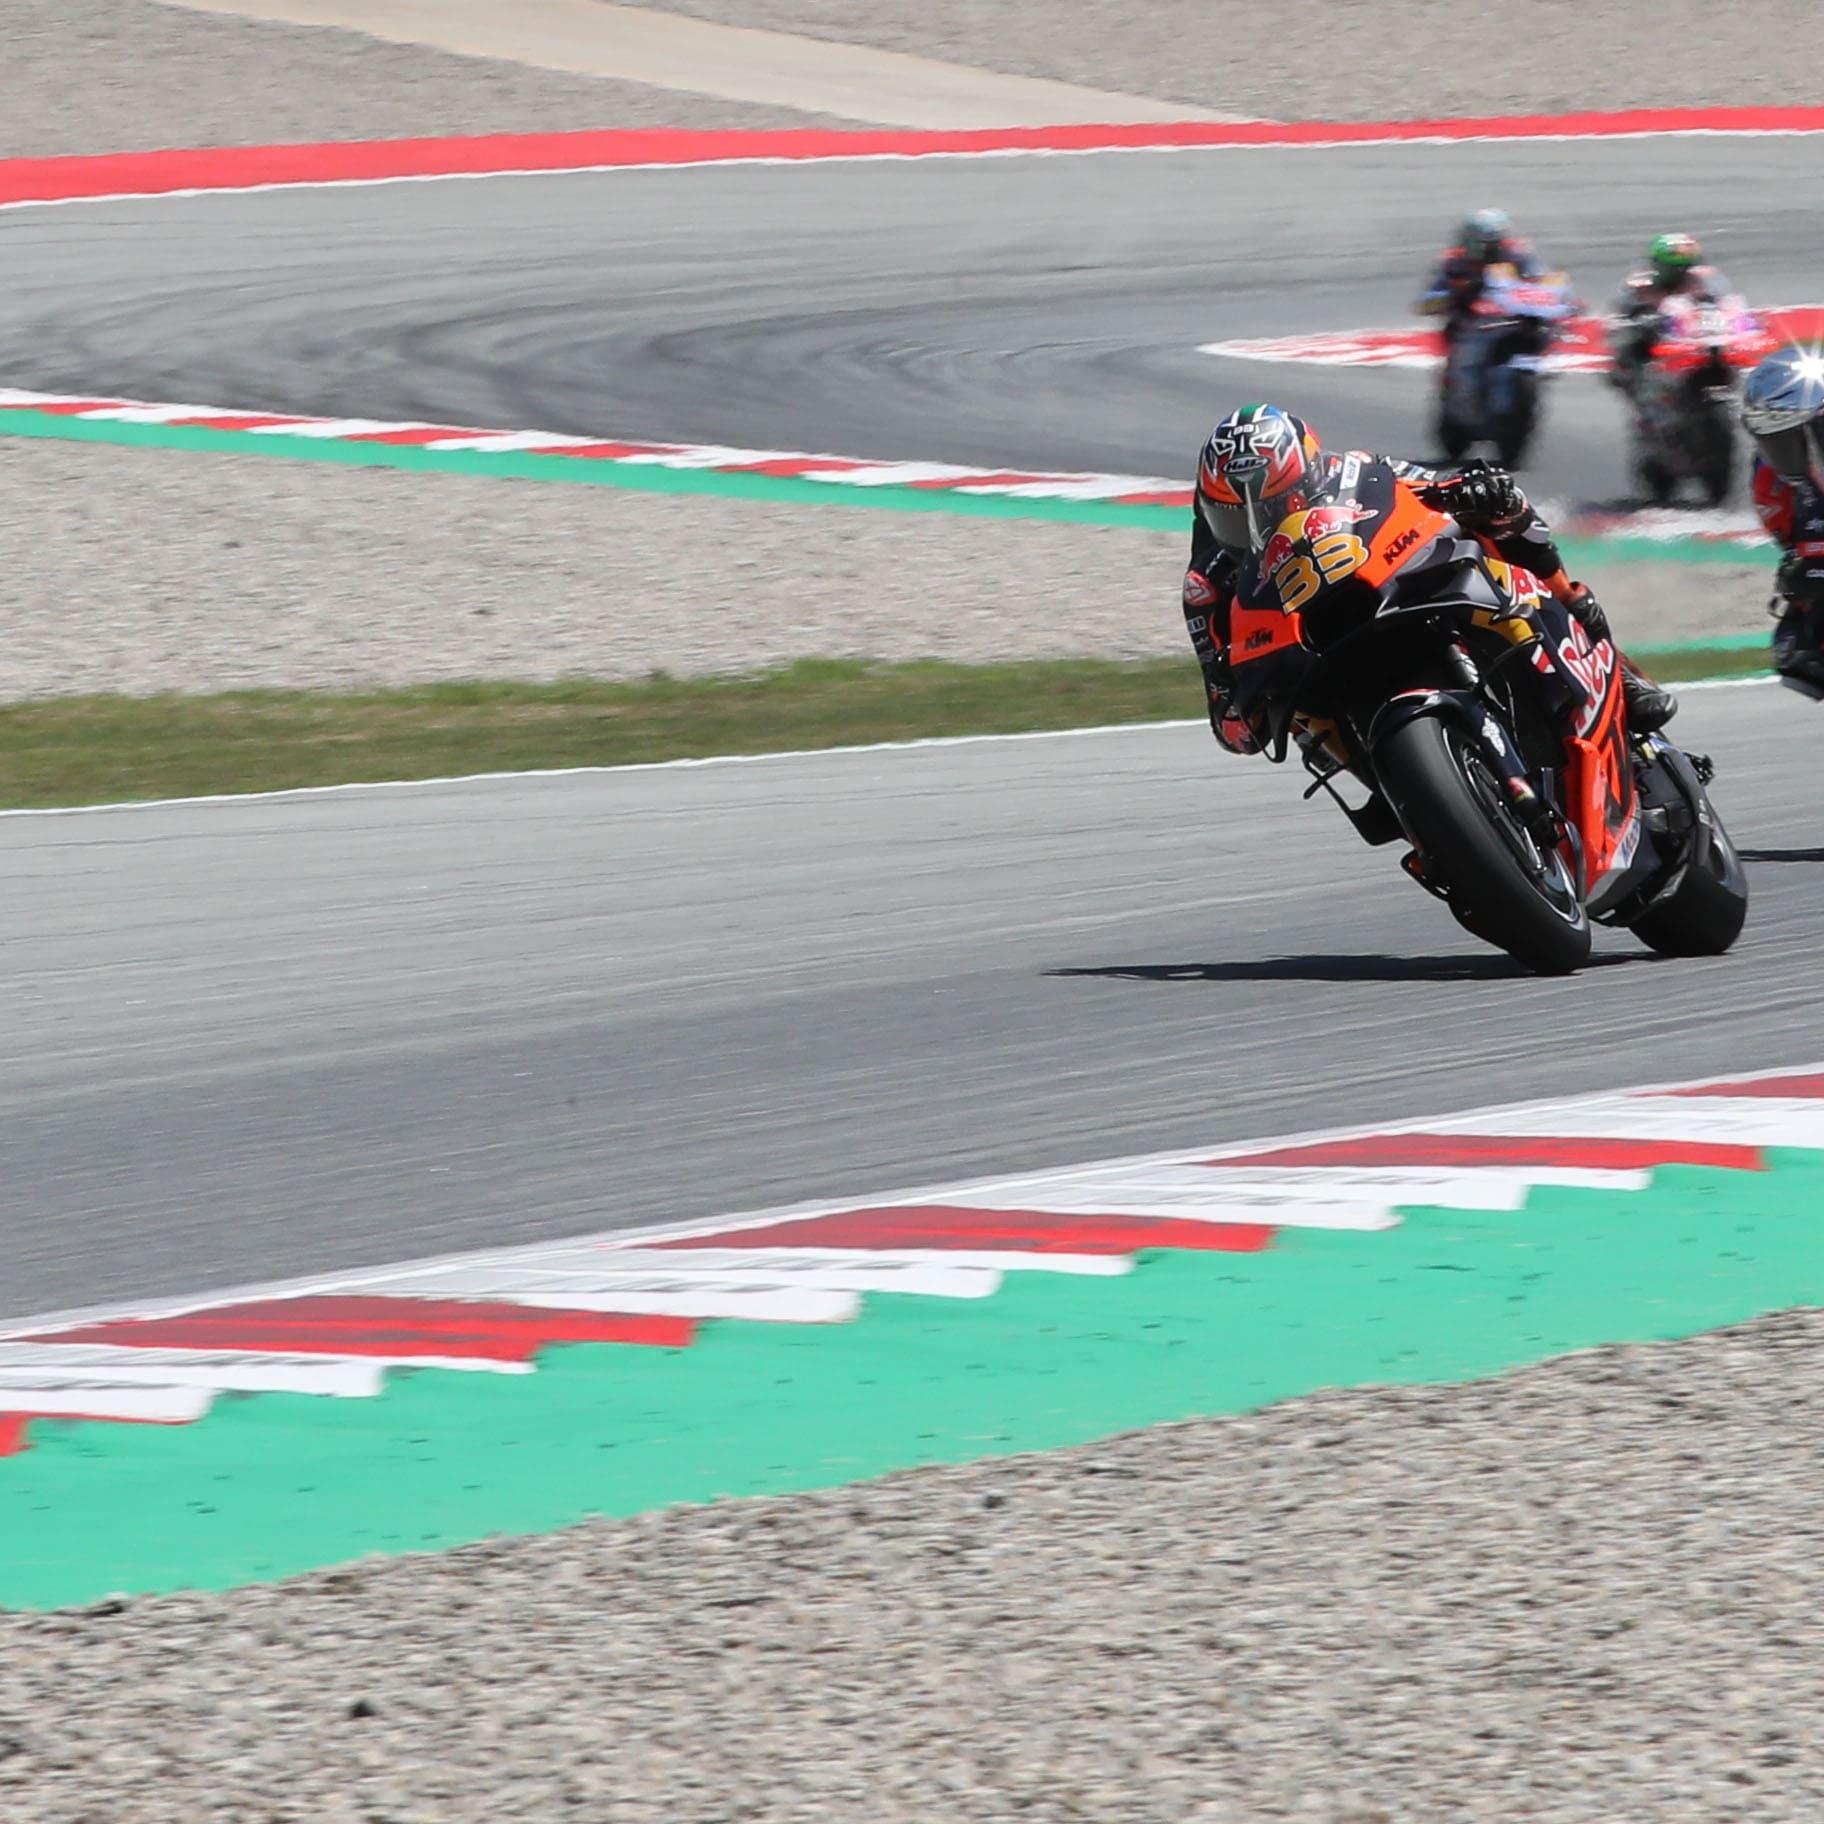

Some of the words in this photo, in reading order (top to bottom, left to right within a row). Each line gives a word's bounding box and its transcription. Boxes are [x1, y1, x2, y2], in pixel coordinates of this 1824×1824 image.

[1382, 528, 1421, 566] KTM
[1275, 532, 1370, 615] 33
[1245, 629, 1273, 650] KTM
